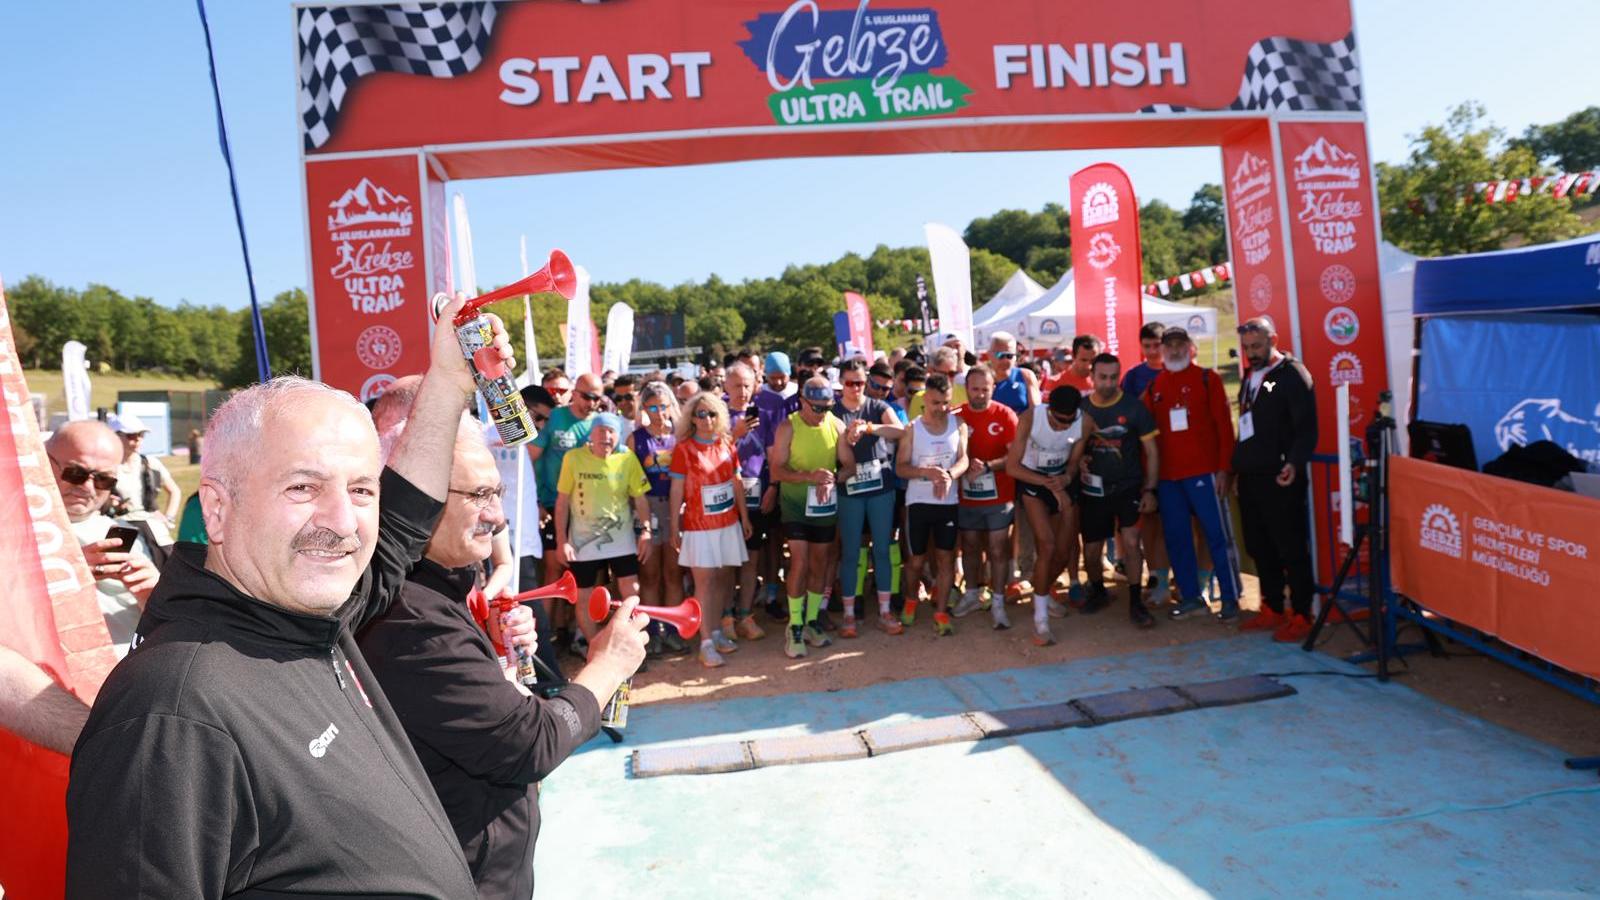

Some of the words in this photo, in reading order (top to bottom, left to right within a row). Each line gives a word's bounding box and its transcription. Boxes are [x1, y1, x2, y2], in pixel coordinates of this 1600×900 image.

[499, 51, 711, 105] START
[992, 42, 1187, 88] FINISH
[779, 92, 866, 124] ULTRA
[878, 82, 954, 114] TRAIL
[1308, 220, 1357, 239] ULTRA
[1313, 236, 1357, 254] TRAIL
[344, 274, 405, 295] ULTRA
[349, 292, 405, 314] TRAIL
[1420, 527, 1462, 550] GEBZE
[1472, 516, 1524, 542] GENÇLİK
[1527, 531, 1544, 547] VE
[1547, 537, 1588, 559] SPOR
[1472, 533, 1541, 565] HİZMETLERİ
[1472, 549, 1551, 587] MÜDÜRLÜĞÜ
